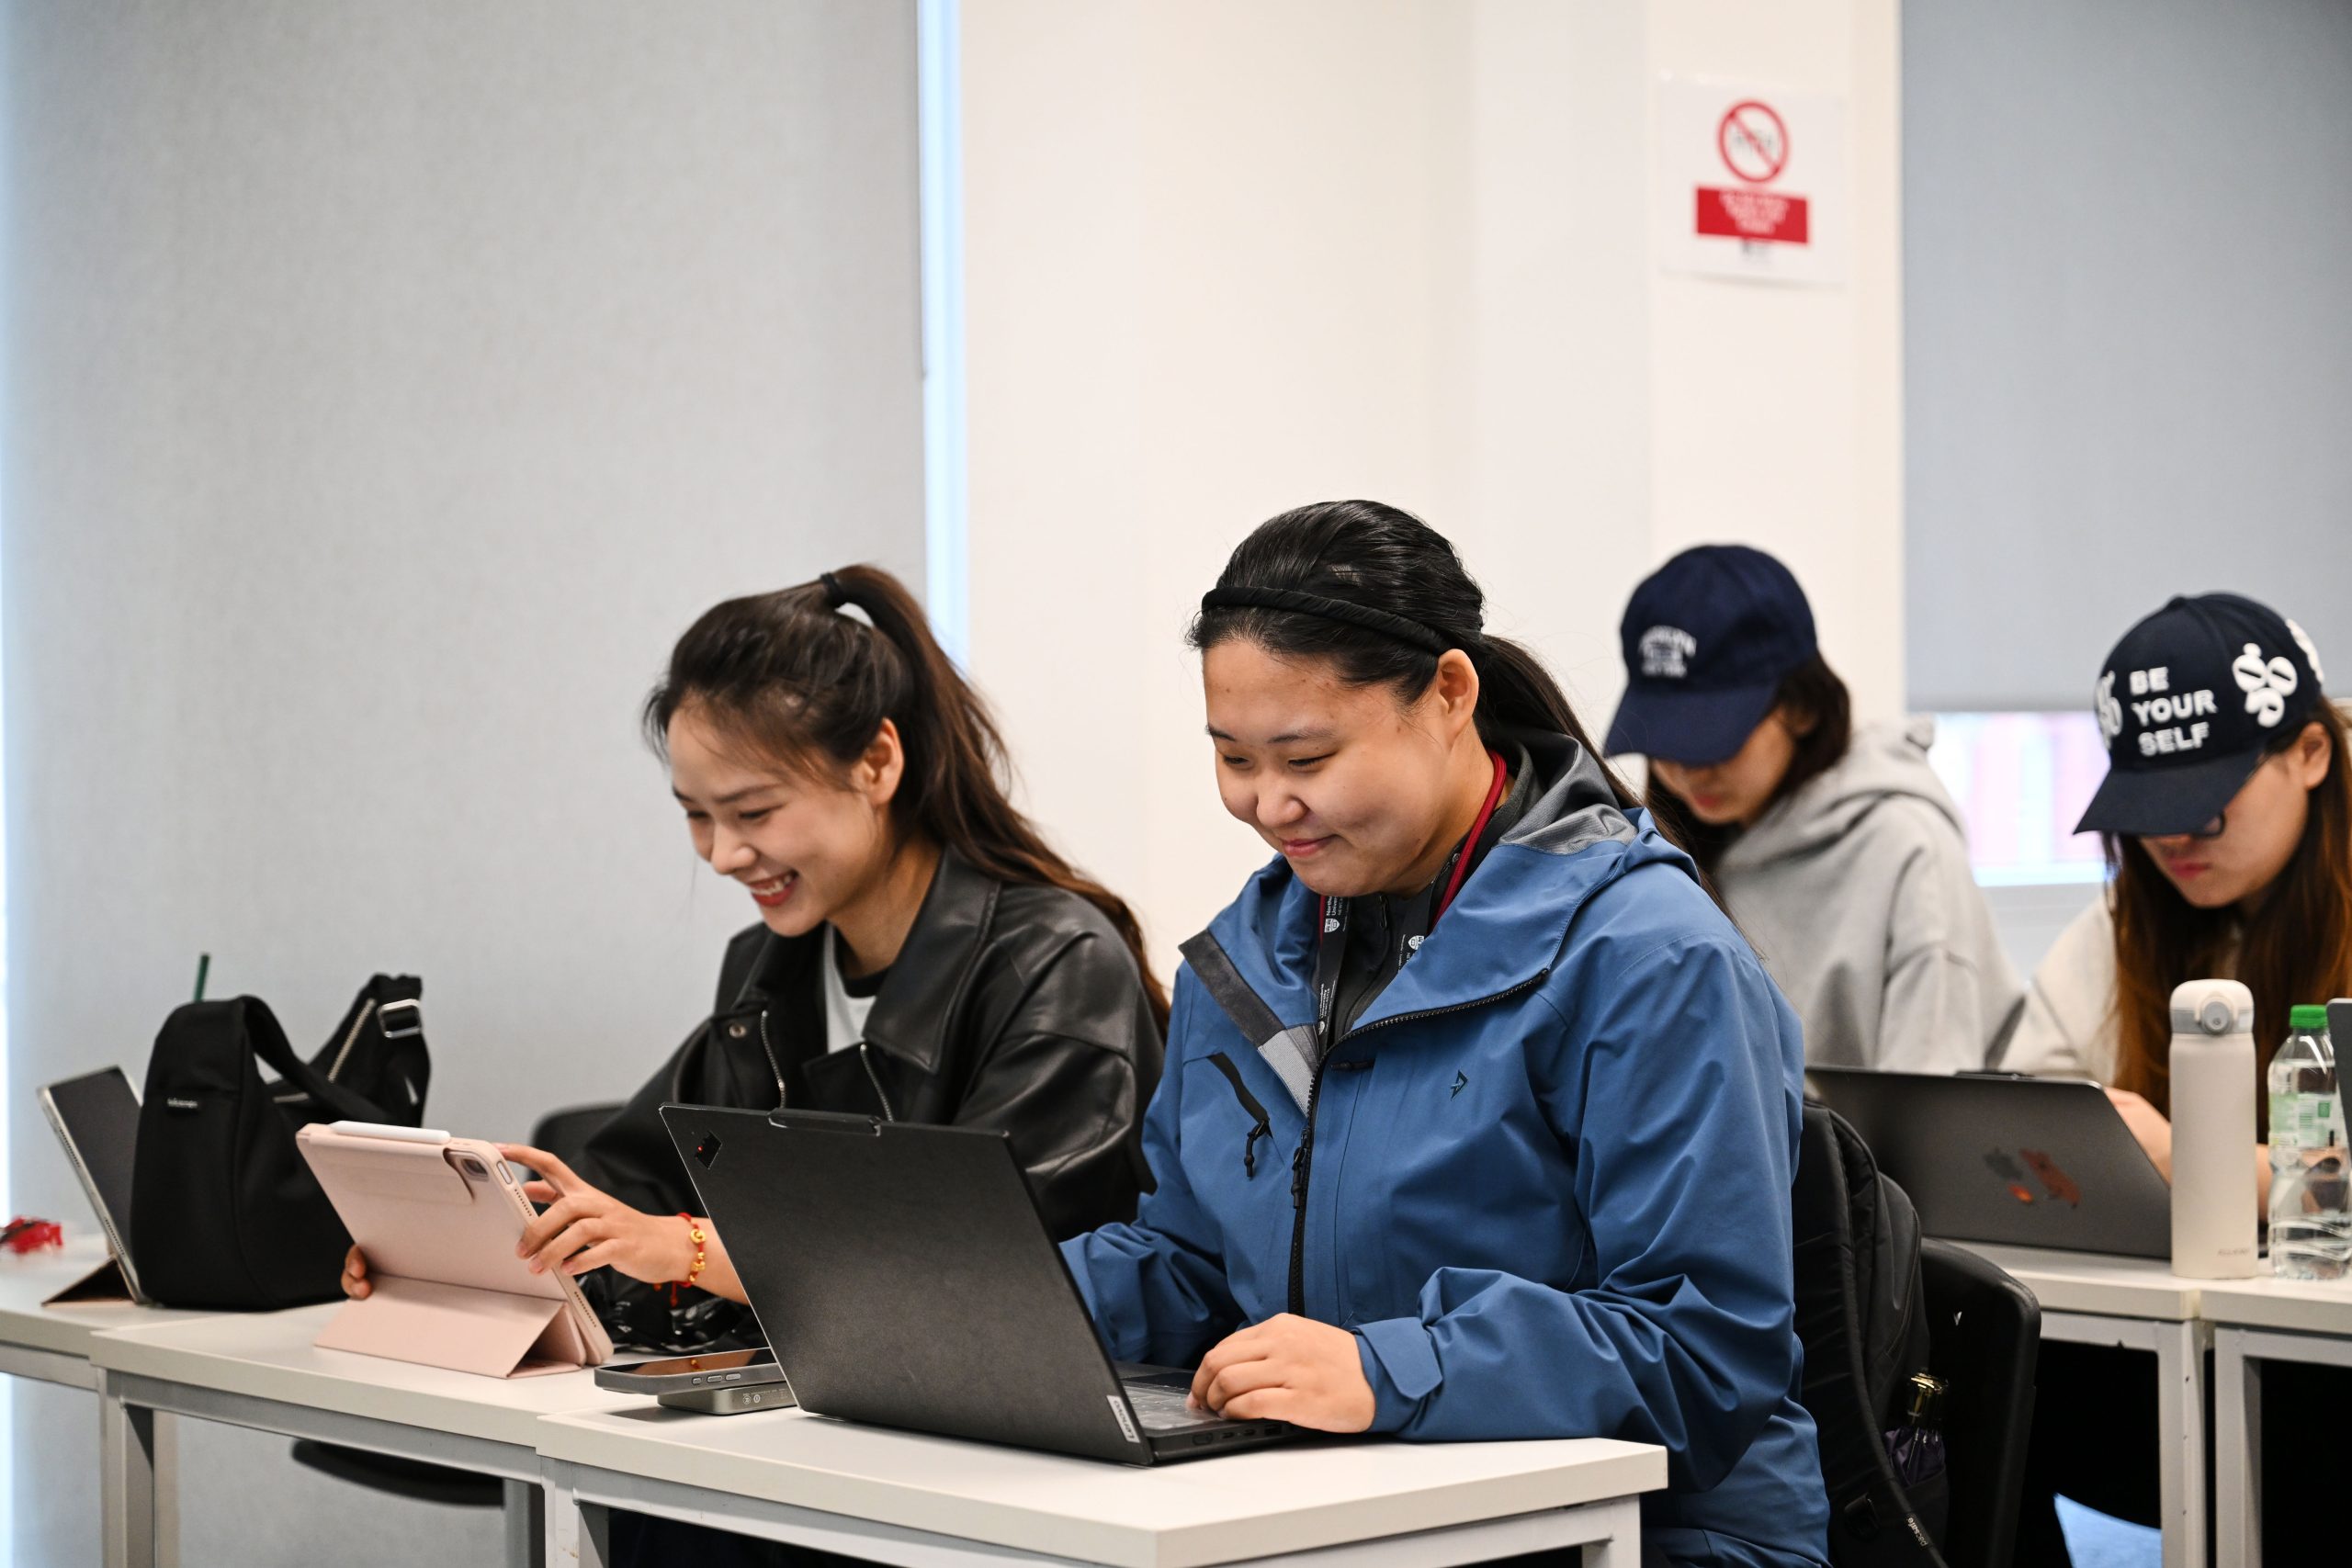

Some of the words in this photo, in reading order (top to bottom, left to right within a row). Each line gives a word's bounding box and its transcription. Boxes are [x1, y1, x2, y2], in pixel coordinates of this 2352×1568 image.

[2130, 667, 2169, 695] BE
[2132, 689, 2218, 727] YOUR
[2138, 721, 2210, 756] SELF
[1114, 1400, 1136, 1439] Lenovo
[1907, 1517, 1928, 1547] pacsafe
